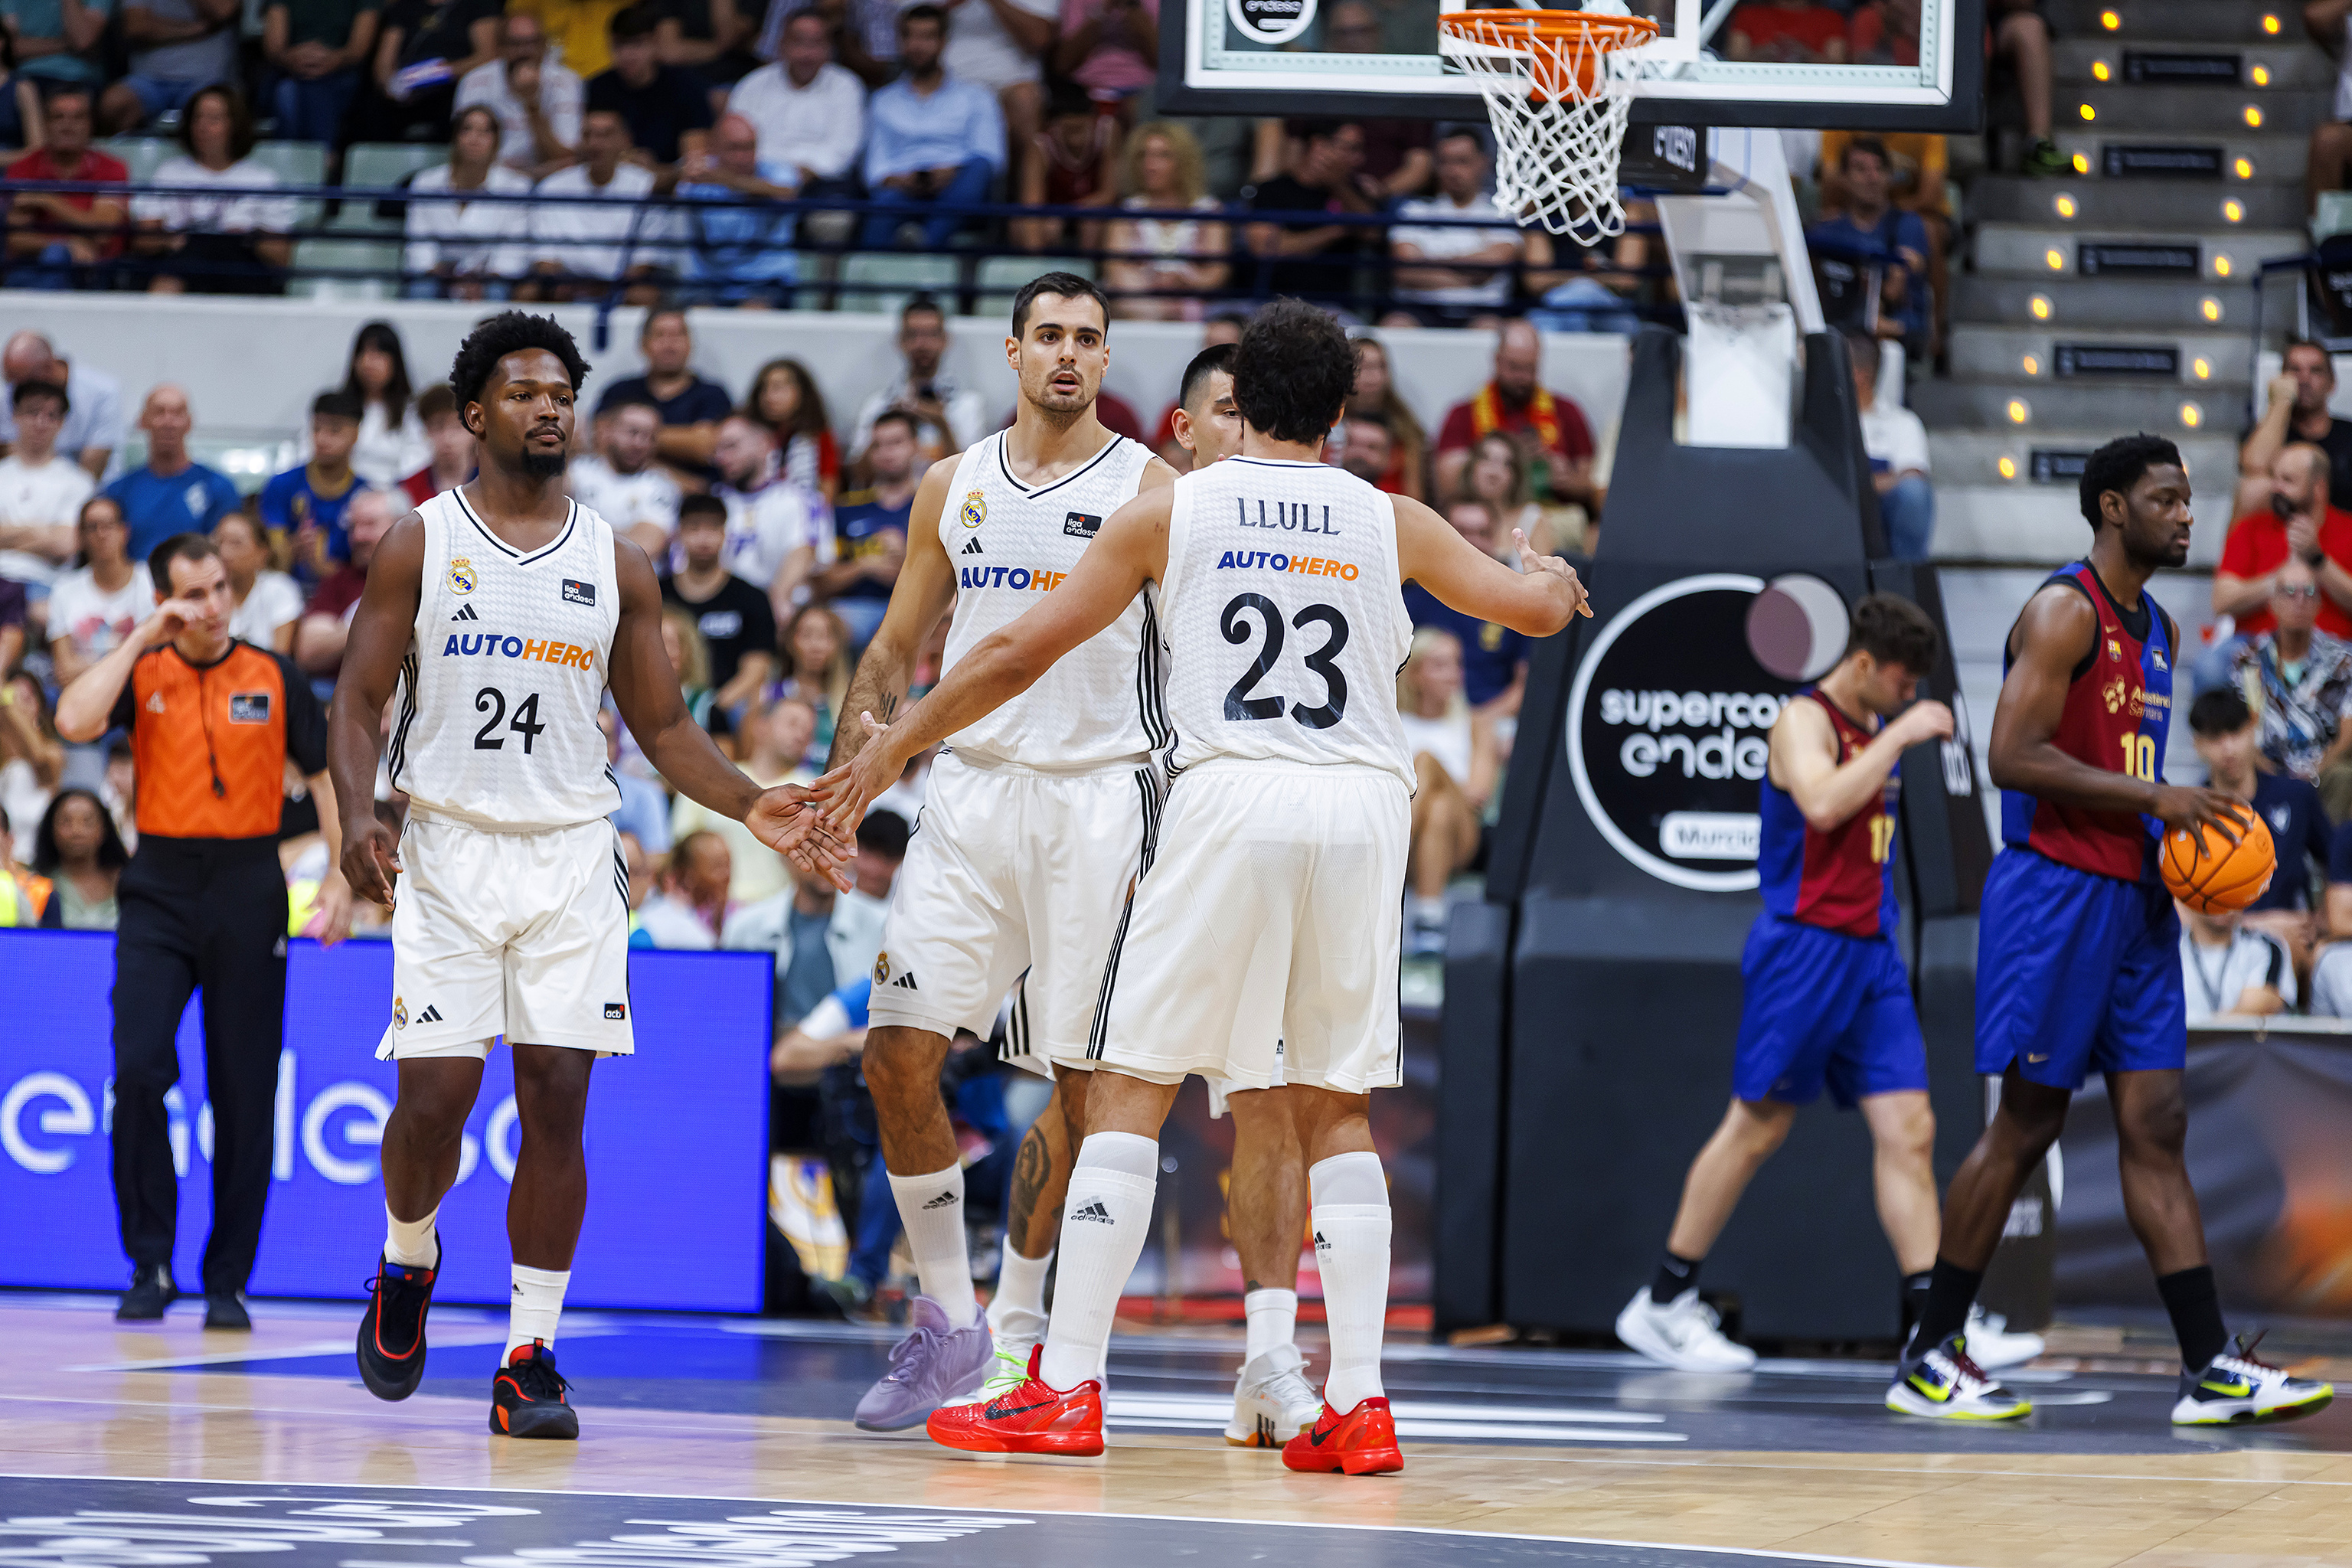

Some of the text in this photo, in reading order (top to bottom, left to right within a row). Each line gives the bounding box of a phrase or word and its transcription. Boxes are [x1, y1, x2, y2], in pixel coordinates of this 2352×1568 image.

[1067, 517, 1083, 528] liga
[1237, 497, 1341, 536] LLULL
[961, 566, 1069, 592] AUTOHE
[1217, 550, 1360, 582] AUTOHERO
[564, 583, 580, 595] liga
[564, 592, 594, 606] endesa
[443, 633, 594, 672] AUTOHERO
[1220, 592, 1350, 730] 23
[473, 686, 547, 756] 24
[1599, 687, 1789, 733] superco
[1619, 725, 1769, 780] ende
[2119, 730, 2157, 784] 10
[605, 1008, 622, 1019] acb
[1070, 1214, 1116, 1225] adidas
